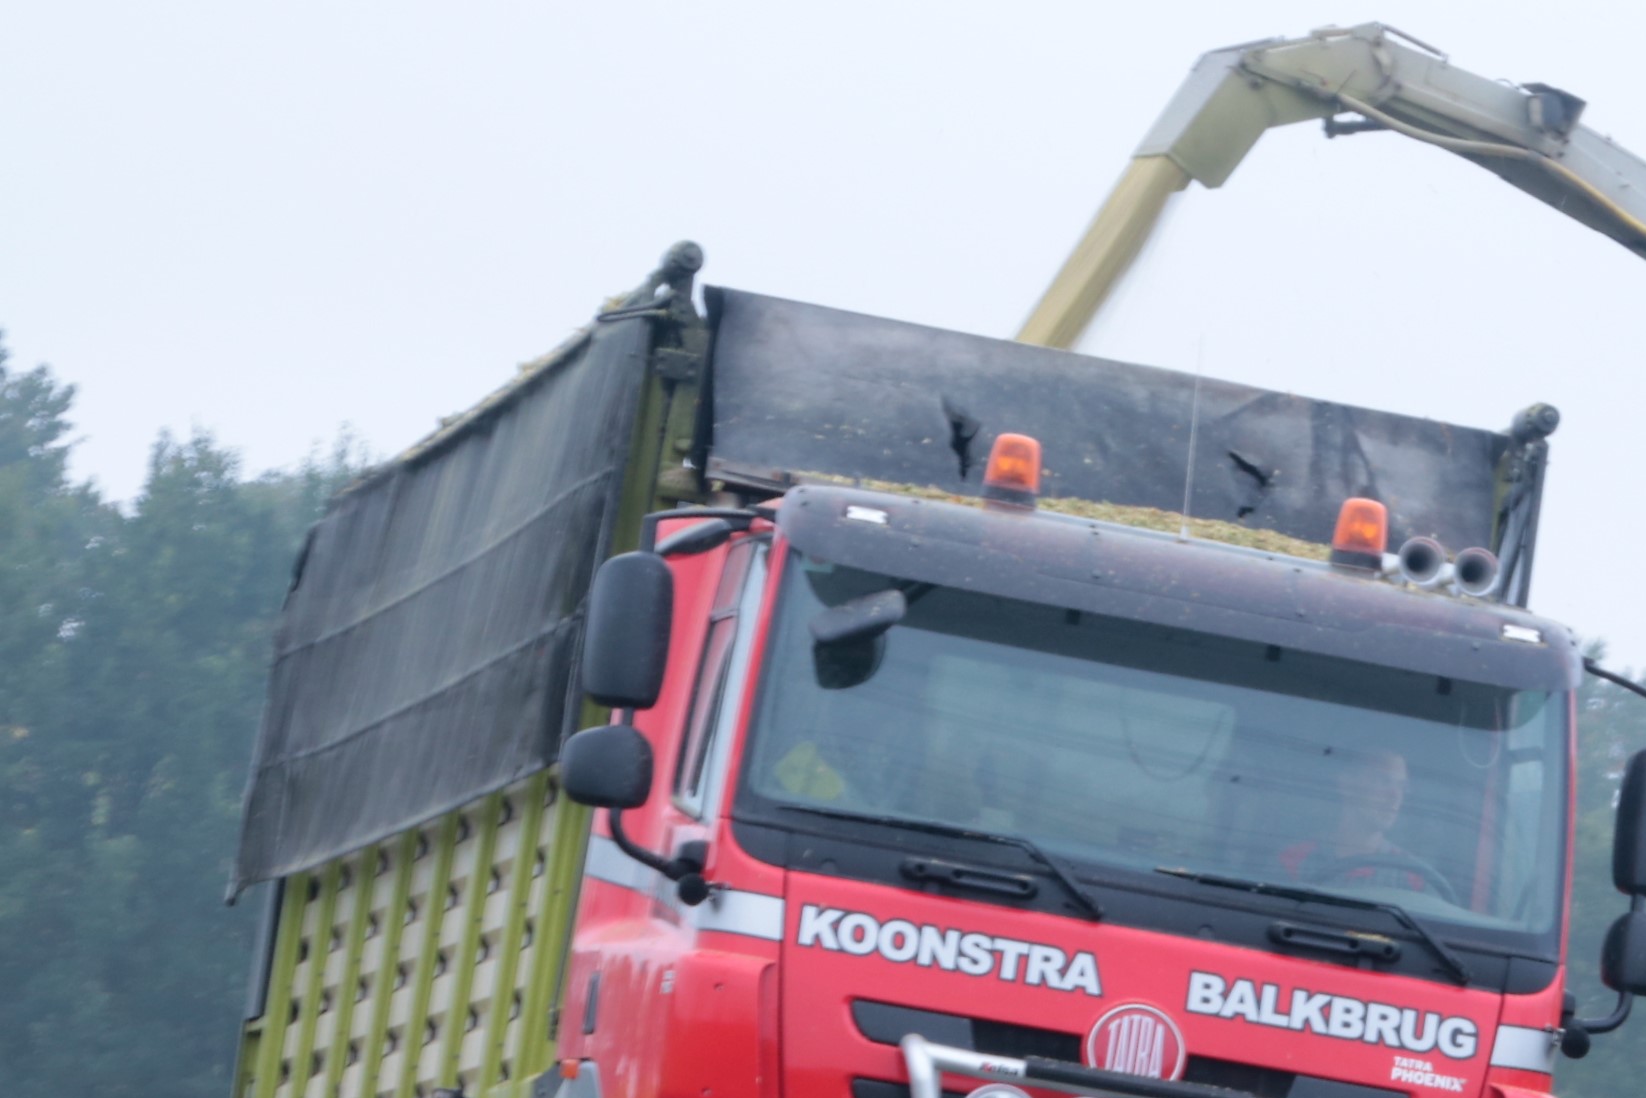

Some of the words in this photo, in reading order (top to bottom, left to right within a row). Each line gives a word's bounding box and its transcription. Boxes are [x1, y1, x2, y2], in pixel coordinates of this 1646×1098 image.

[798, 904, 1103, 996] KOONSTRA
[1186, 970, 1478, 1059] BALKBRUG
[1104, 1014, 1165, 1079] TATRA
[1394, 1056, 1433, 1071] TATRA
[1391, 1067, 1465, 1092] PHOENIX
